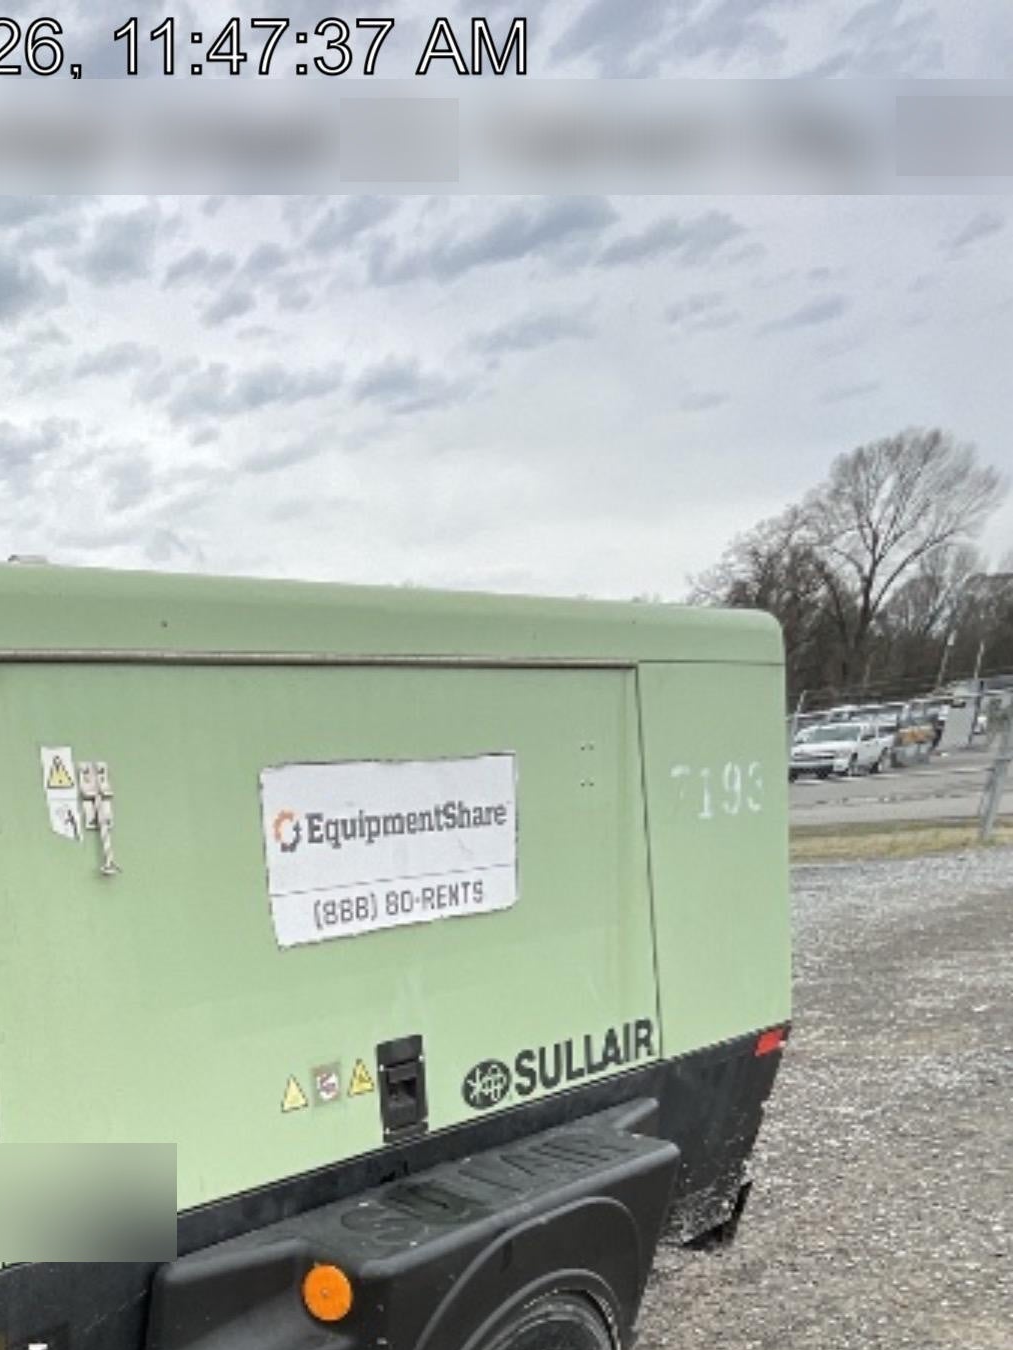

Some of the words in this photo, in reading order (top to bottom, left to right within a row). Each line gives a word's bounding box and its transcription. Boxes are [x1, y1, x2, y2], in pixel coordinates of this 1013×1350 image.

[305, 801, 507, 849] EquipmentShare
[313, 890, 378, 929] (888)
[385, 879, 484, 916] 80-RENTS
[514, 1017, 654, 1096] SULLAIR
